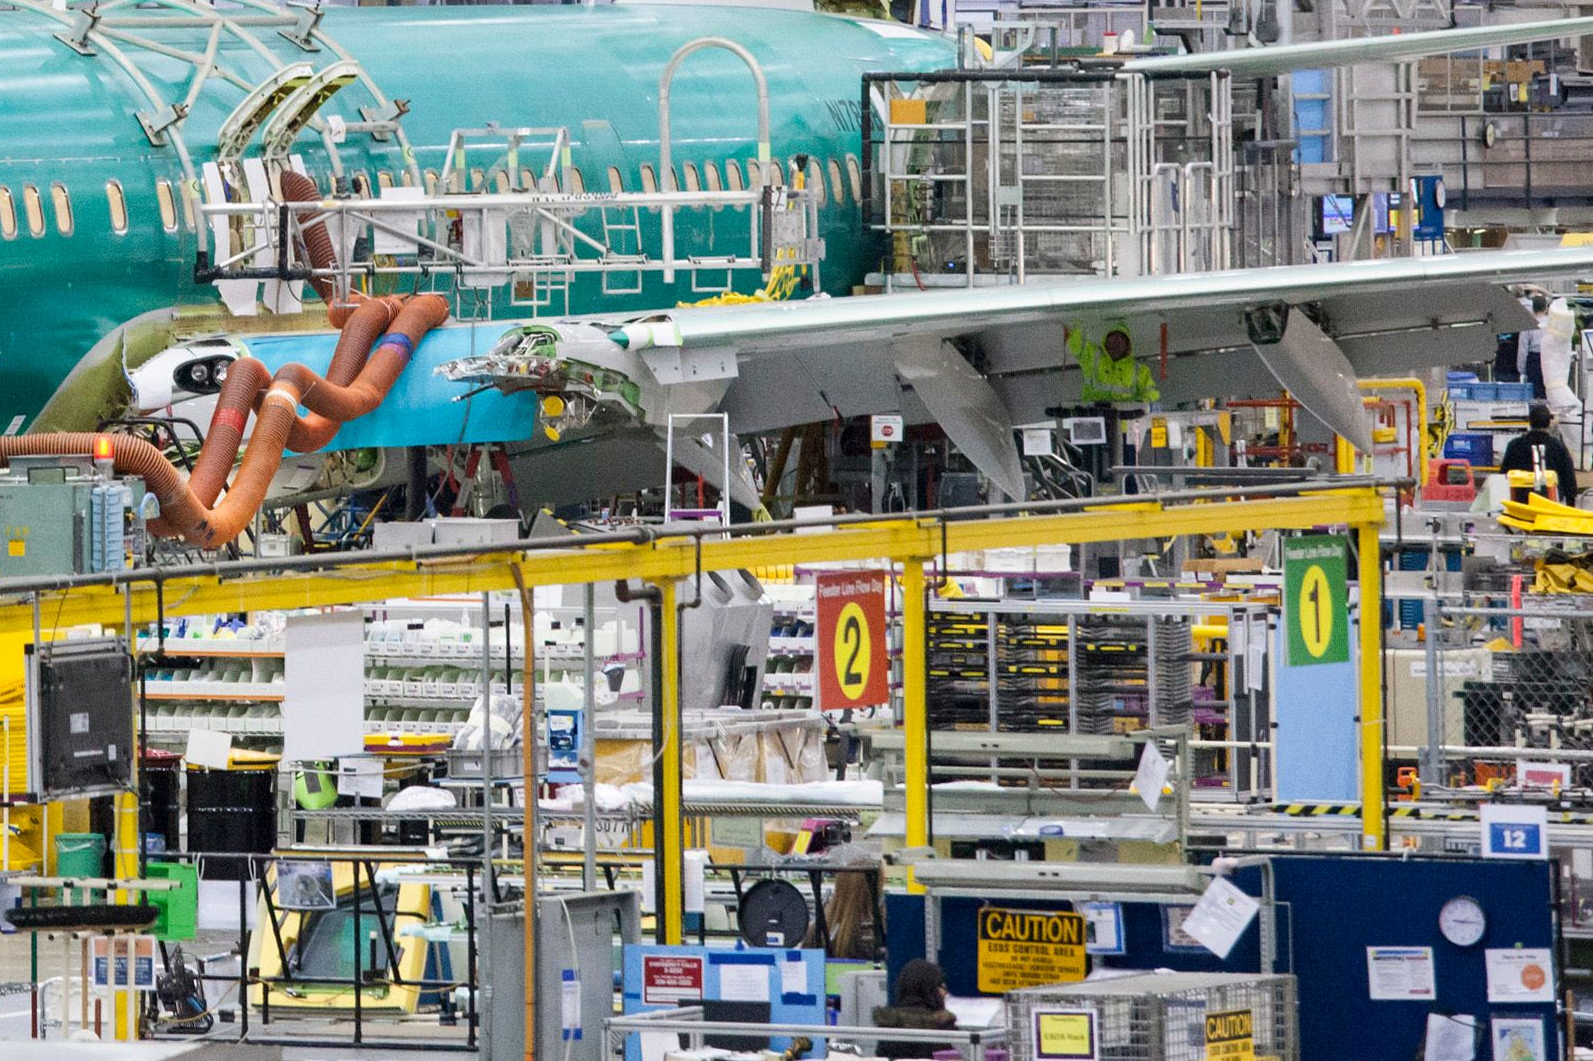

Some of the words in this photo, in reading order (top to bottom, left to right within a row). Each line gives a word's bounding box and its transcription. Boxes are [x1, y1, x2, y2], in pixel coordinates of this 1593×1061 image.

[1309, 580, 1320, 643] 1
[844, 615, 862, 685] 2
[1503, 829, 1526, 848] 12
[987, 911, 1078, 943] CAUTION
[1207, 1014, 1252, 1040] CAUTION
